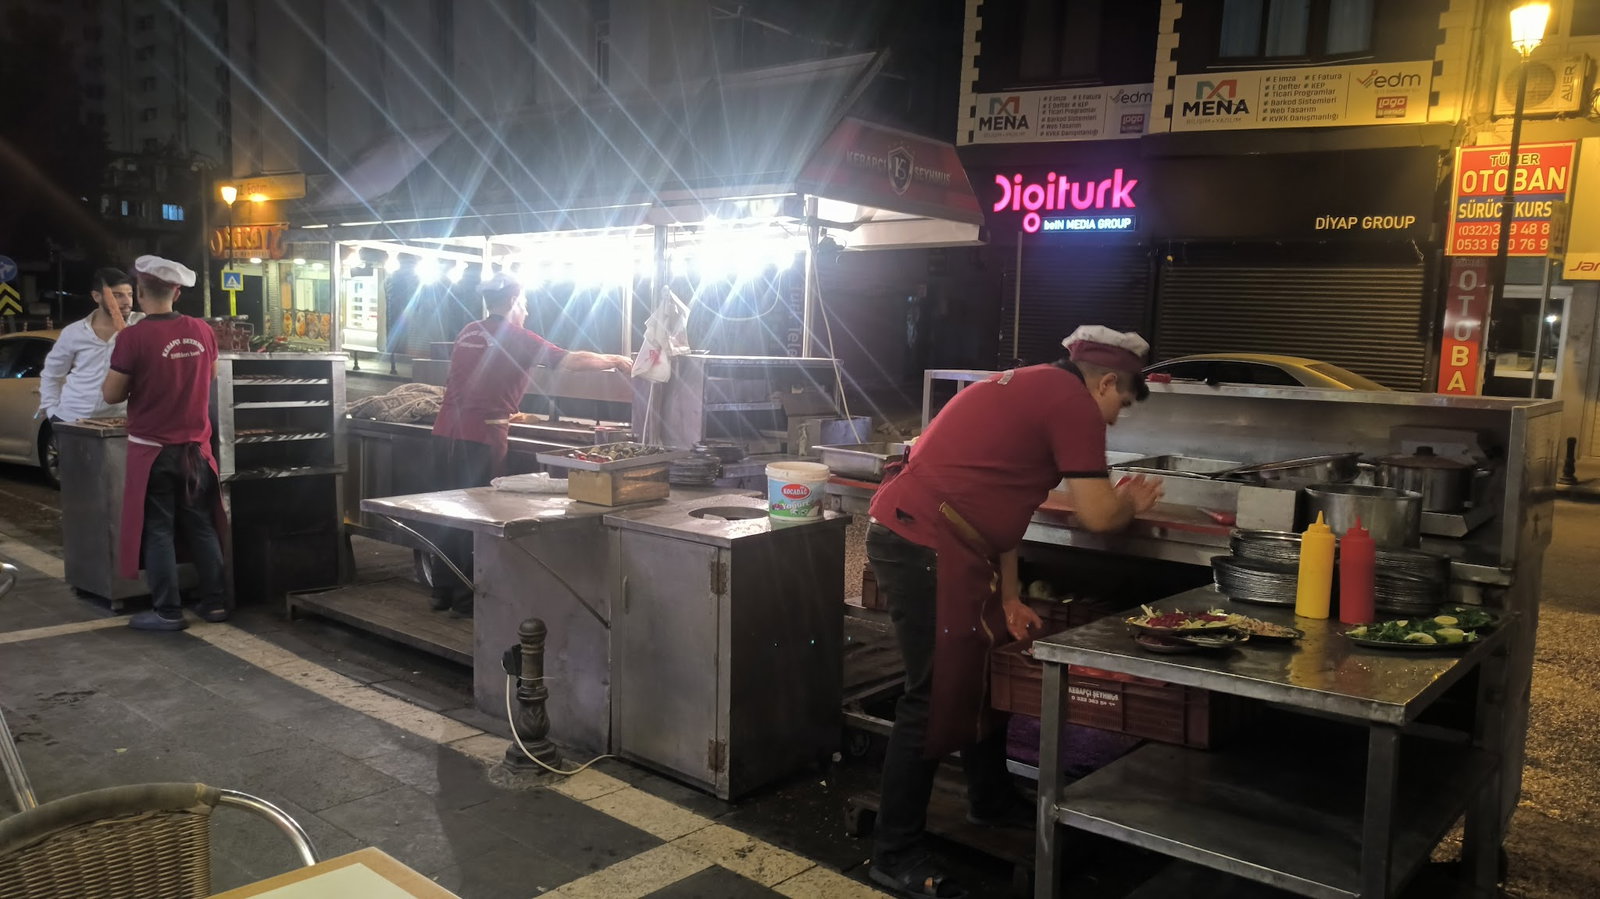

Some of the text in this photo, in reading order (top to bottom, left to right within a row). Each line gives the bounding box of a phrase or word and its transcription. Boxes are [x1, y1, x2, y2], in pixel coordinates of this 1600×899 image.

[1374, 72, 1421, 88] edm
[1121, 90, 1152, 104] edm
[1294, 89, 1336, 97] Programlar
[1182, 99, 1250, 117] MENA
[979, 114, 1030, 131] MENA
[1490, 151, 1540, 167] TÜER
[1462, 166, 1566, 193] OTOBAN
[994, 169, 1138, 232] Digiturk
[1458, 198, 1552, 219] SÜRÜC KURS
[1066, 219, 1096, 230] MEDIA
[1098, 218, 1131, 229] GROUP
[1315, 215, 1416, 230] DİYAP GROUP
[1520, 223, 1538, 235] 48
[1541, 223, 1550, 235] 8
[1456, 239, 1487, 251] 0533
[1520, 238, 1536, 250] 76
[1540, 238, 1548, 250] 9
[1446, 270, 1478, 391] OTOBA
